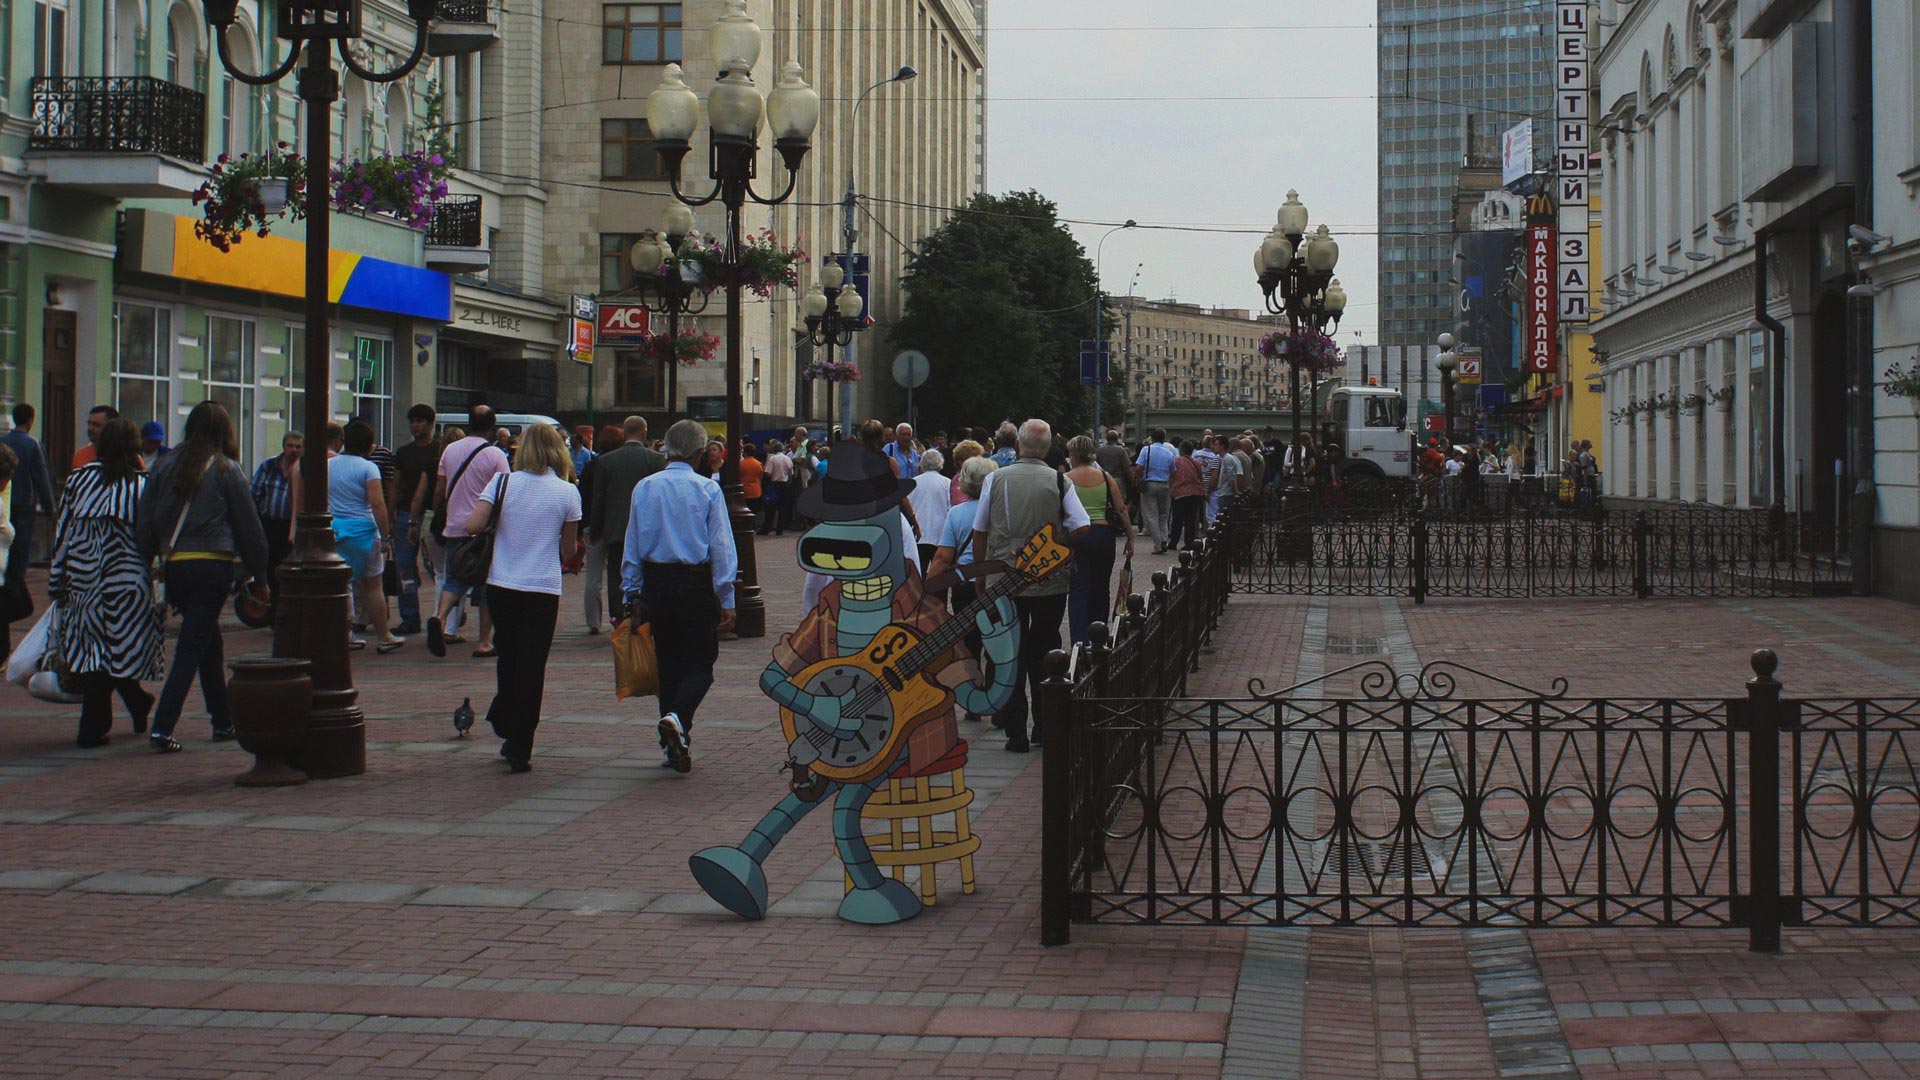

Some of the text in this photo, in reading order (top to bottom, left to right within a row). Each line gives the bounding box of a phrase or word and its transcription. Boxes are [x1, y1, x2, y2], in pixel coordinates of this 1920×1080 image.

[1534, 227, 1549, 369] МАКДОНАЛДС
[1563, 239, 1585, 315] ЗАЛ
[491, 312, 521, 332] HERE
